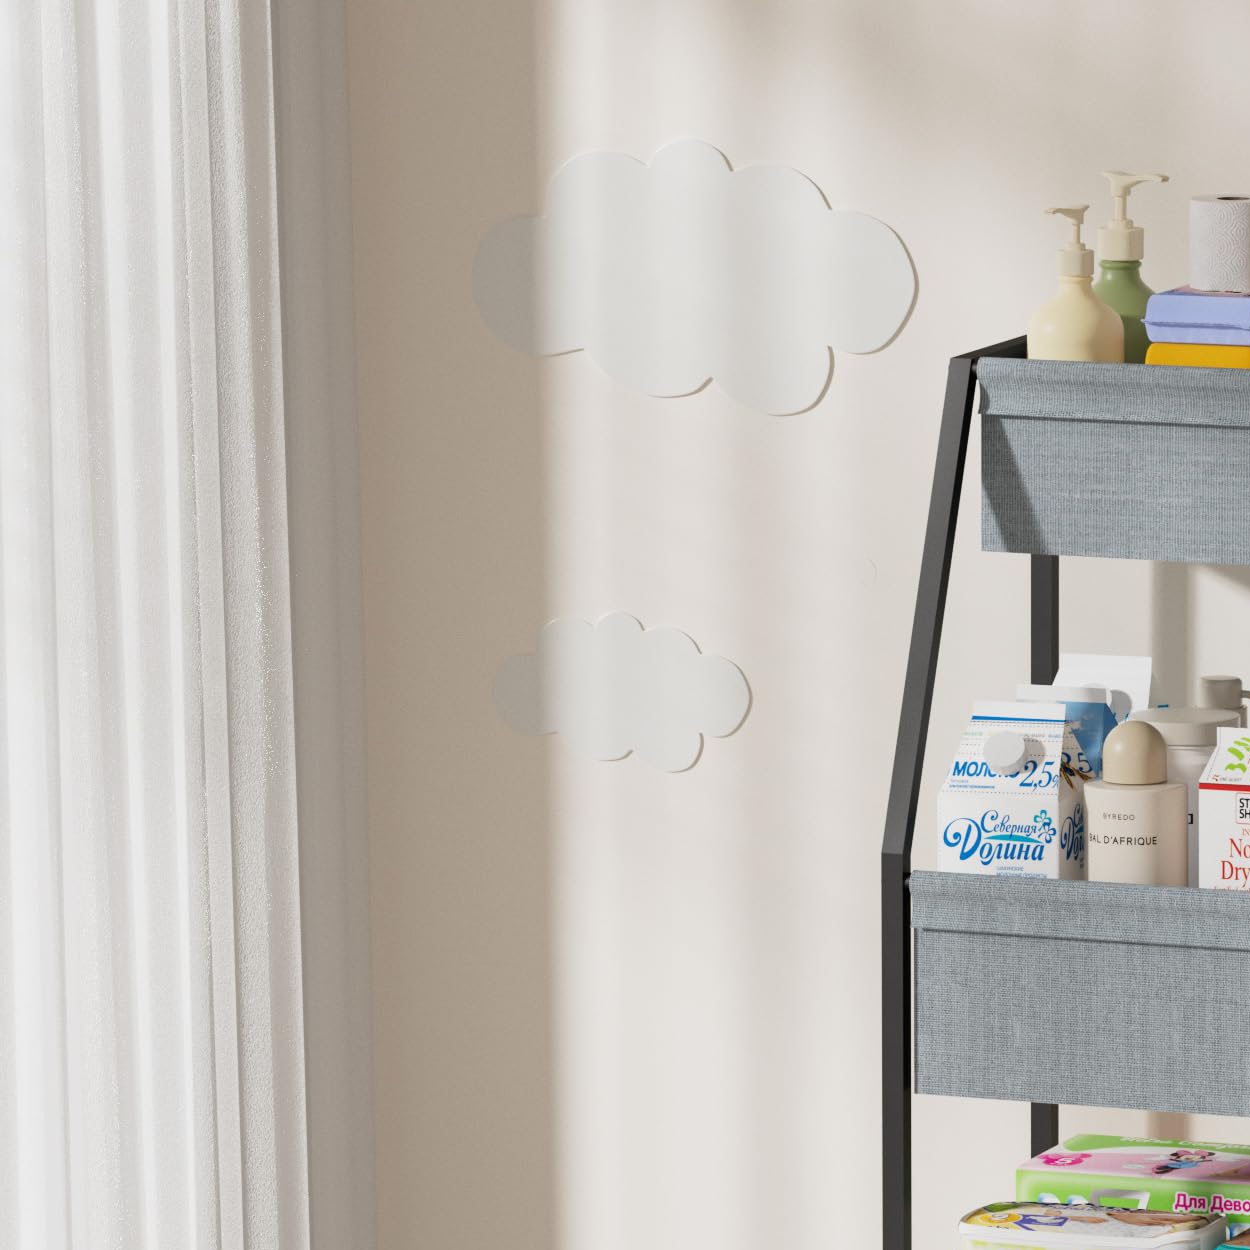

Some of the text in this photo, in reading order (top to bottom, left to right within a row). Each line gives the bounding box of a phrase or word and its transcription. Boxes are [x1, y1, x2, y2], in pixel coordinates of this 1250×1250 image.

[952, 760, 1021, 778] МОЛ
[980, 809, 1037, 837] Северная
[943, 817, 1045, 866] Долина
[1103, 835, 1158, 846] D'AFRIQUE
[1174, 1192, 1206, 1212] Для
